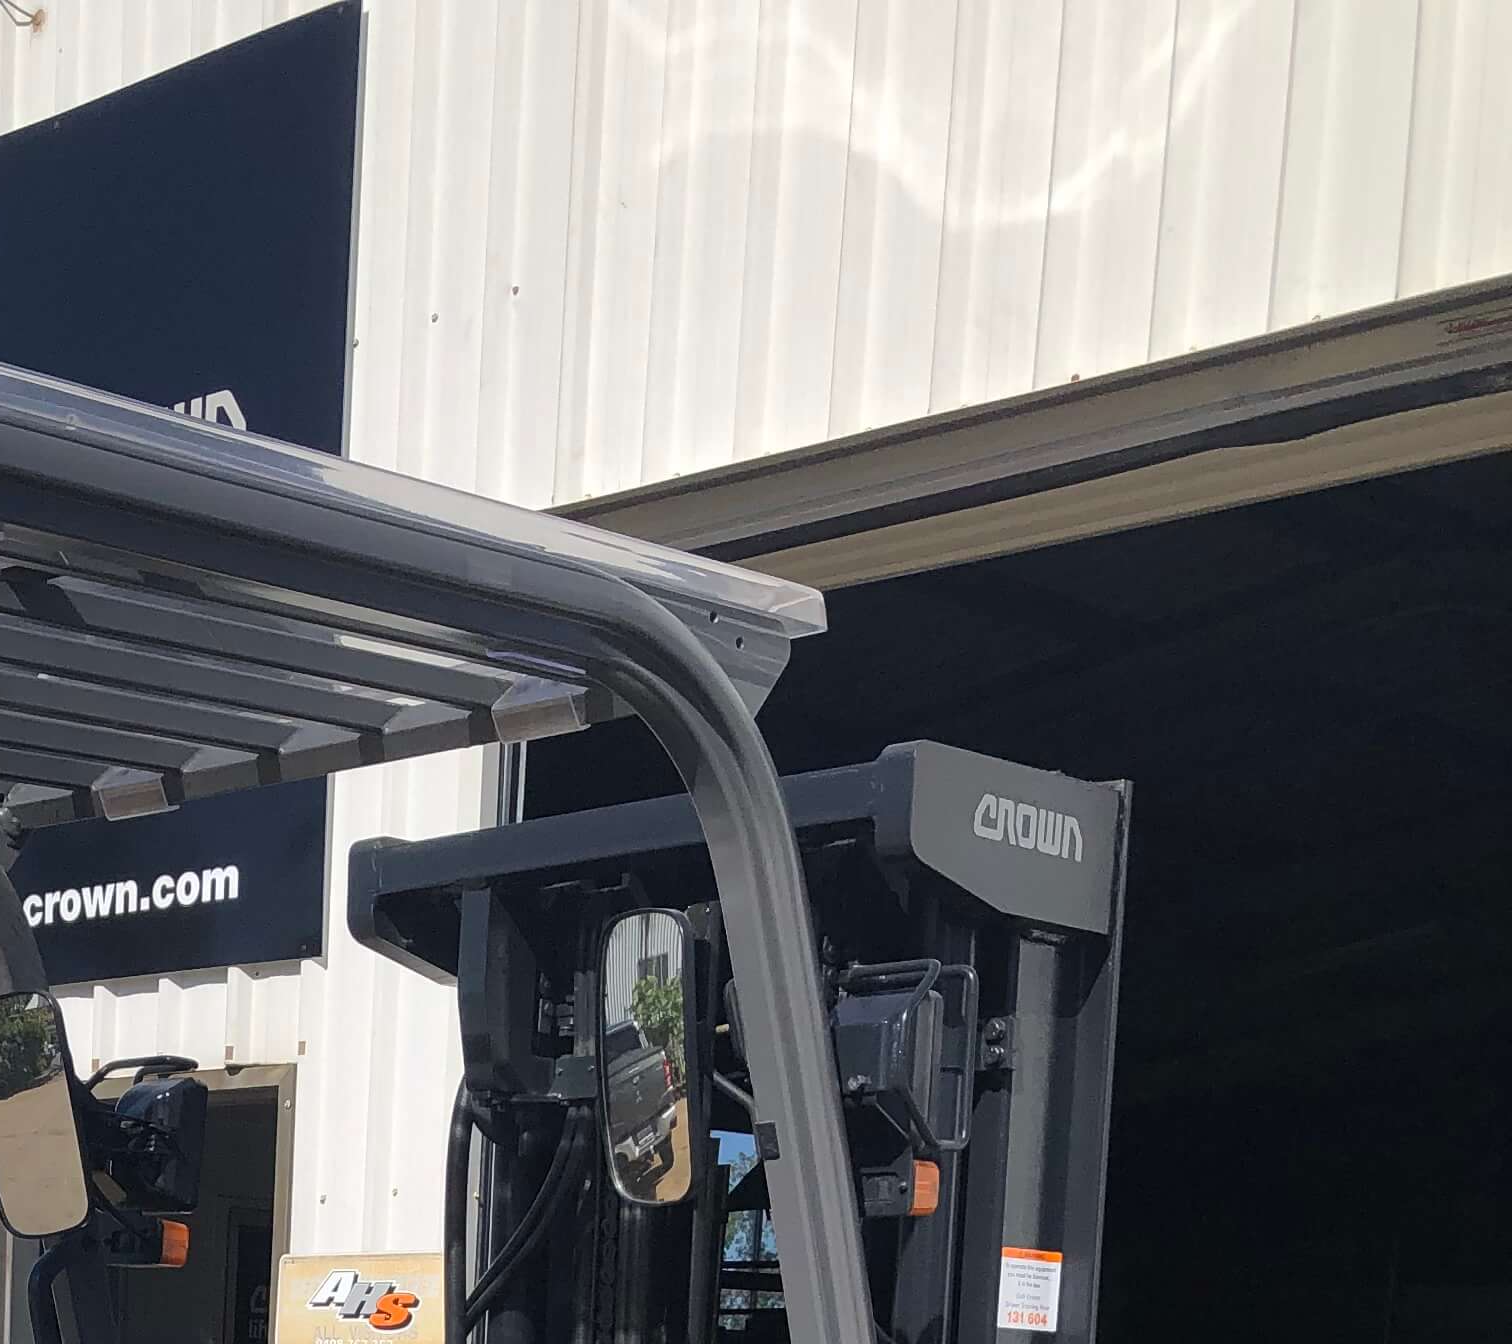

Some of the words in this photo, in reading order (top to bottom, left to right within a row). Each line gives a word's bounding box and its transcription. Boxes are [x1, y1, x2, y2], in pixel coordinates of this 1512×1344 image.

[974, 793, 1083, 862] CROWN
[22, 864, 240, 928] crown.com
[308, 1269, 422, 1333] AHS
[1027, 1312, 1049, 1327] 604
